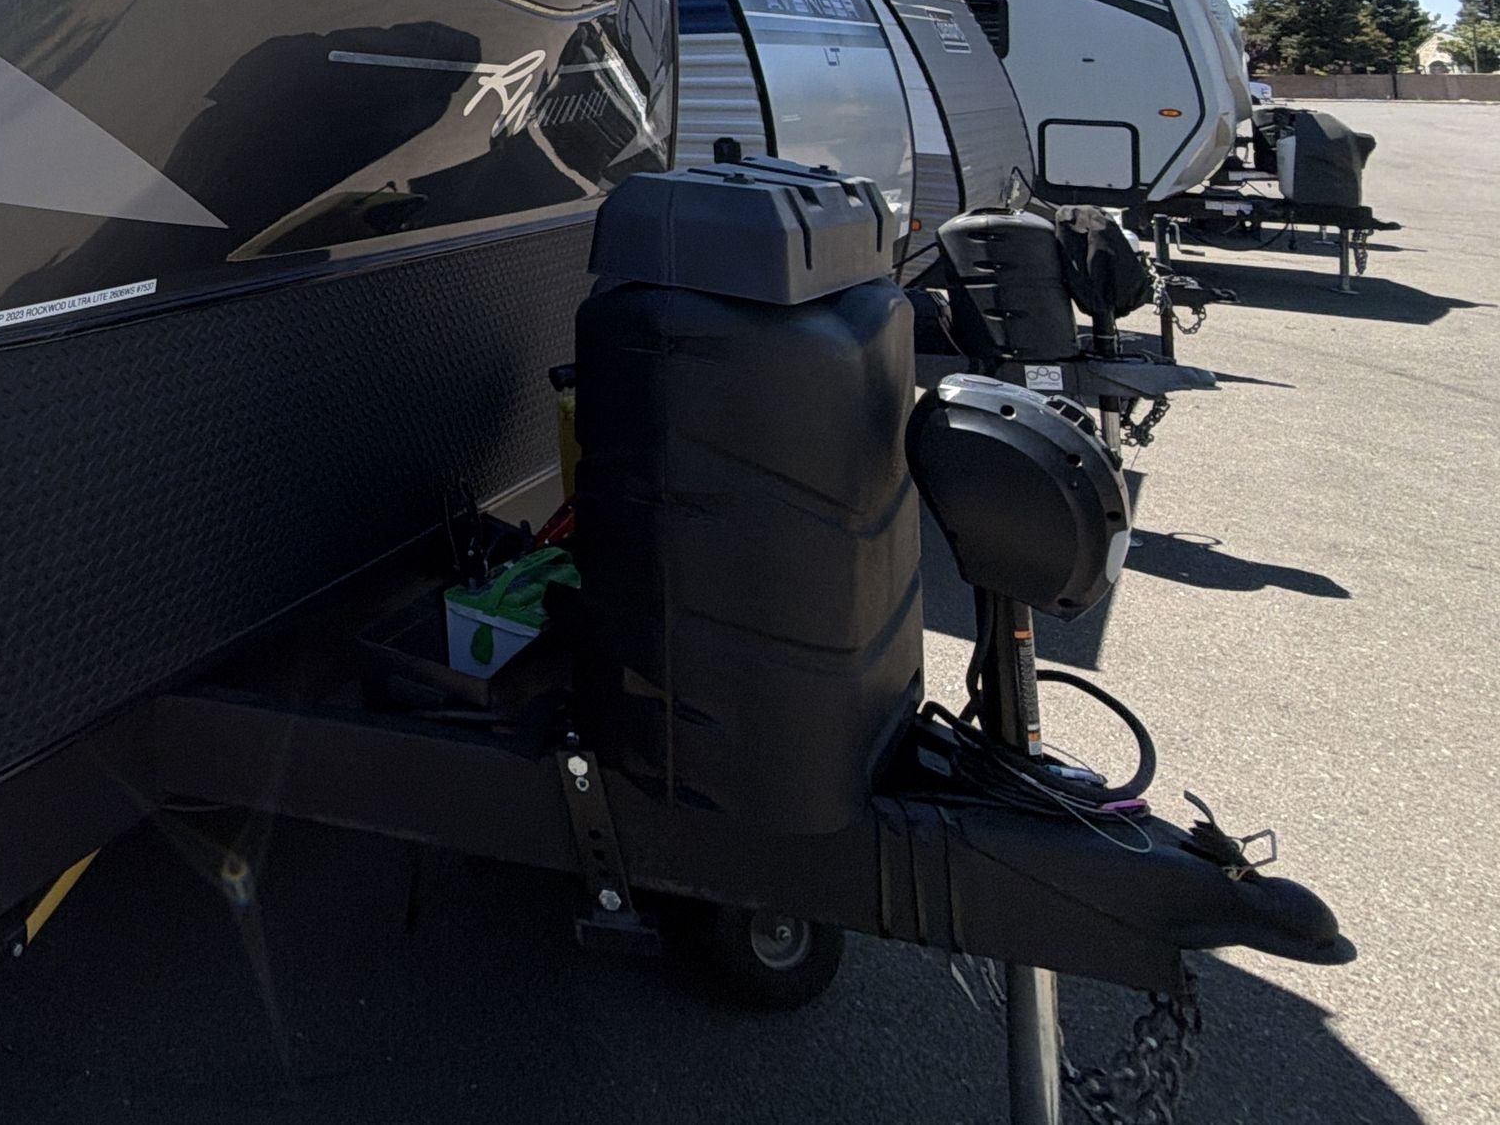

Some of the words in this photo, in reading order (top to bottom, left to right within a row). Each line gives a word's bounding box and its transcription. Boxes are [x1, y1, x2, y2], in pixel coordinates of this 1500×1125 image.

[5, 309, 24, 322] 2023
[67, 295, 92, 309] ULTRA
[92, 290, 109, 304] LITE
